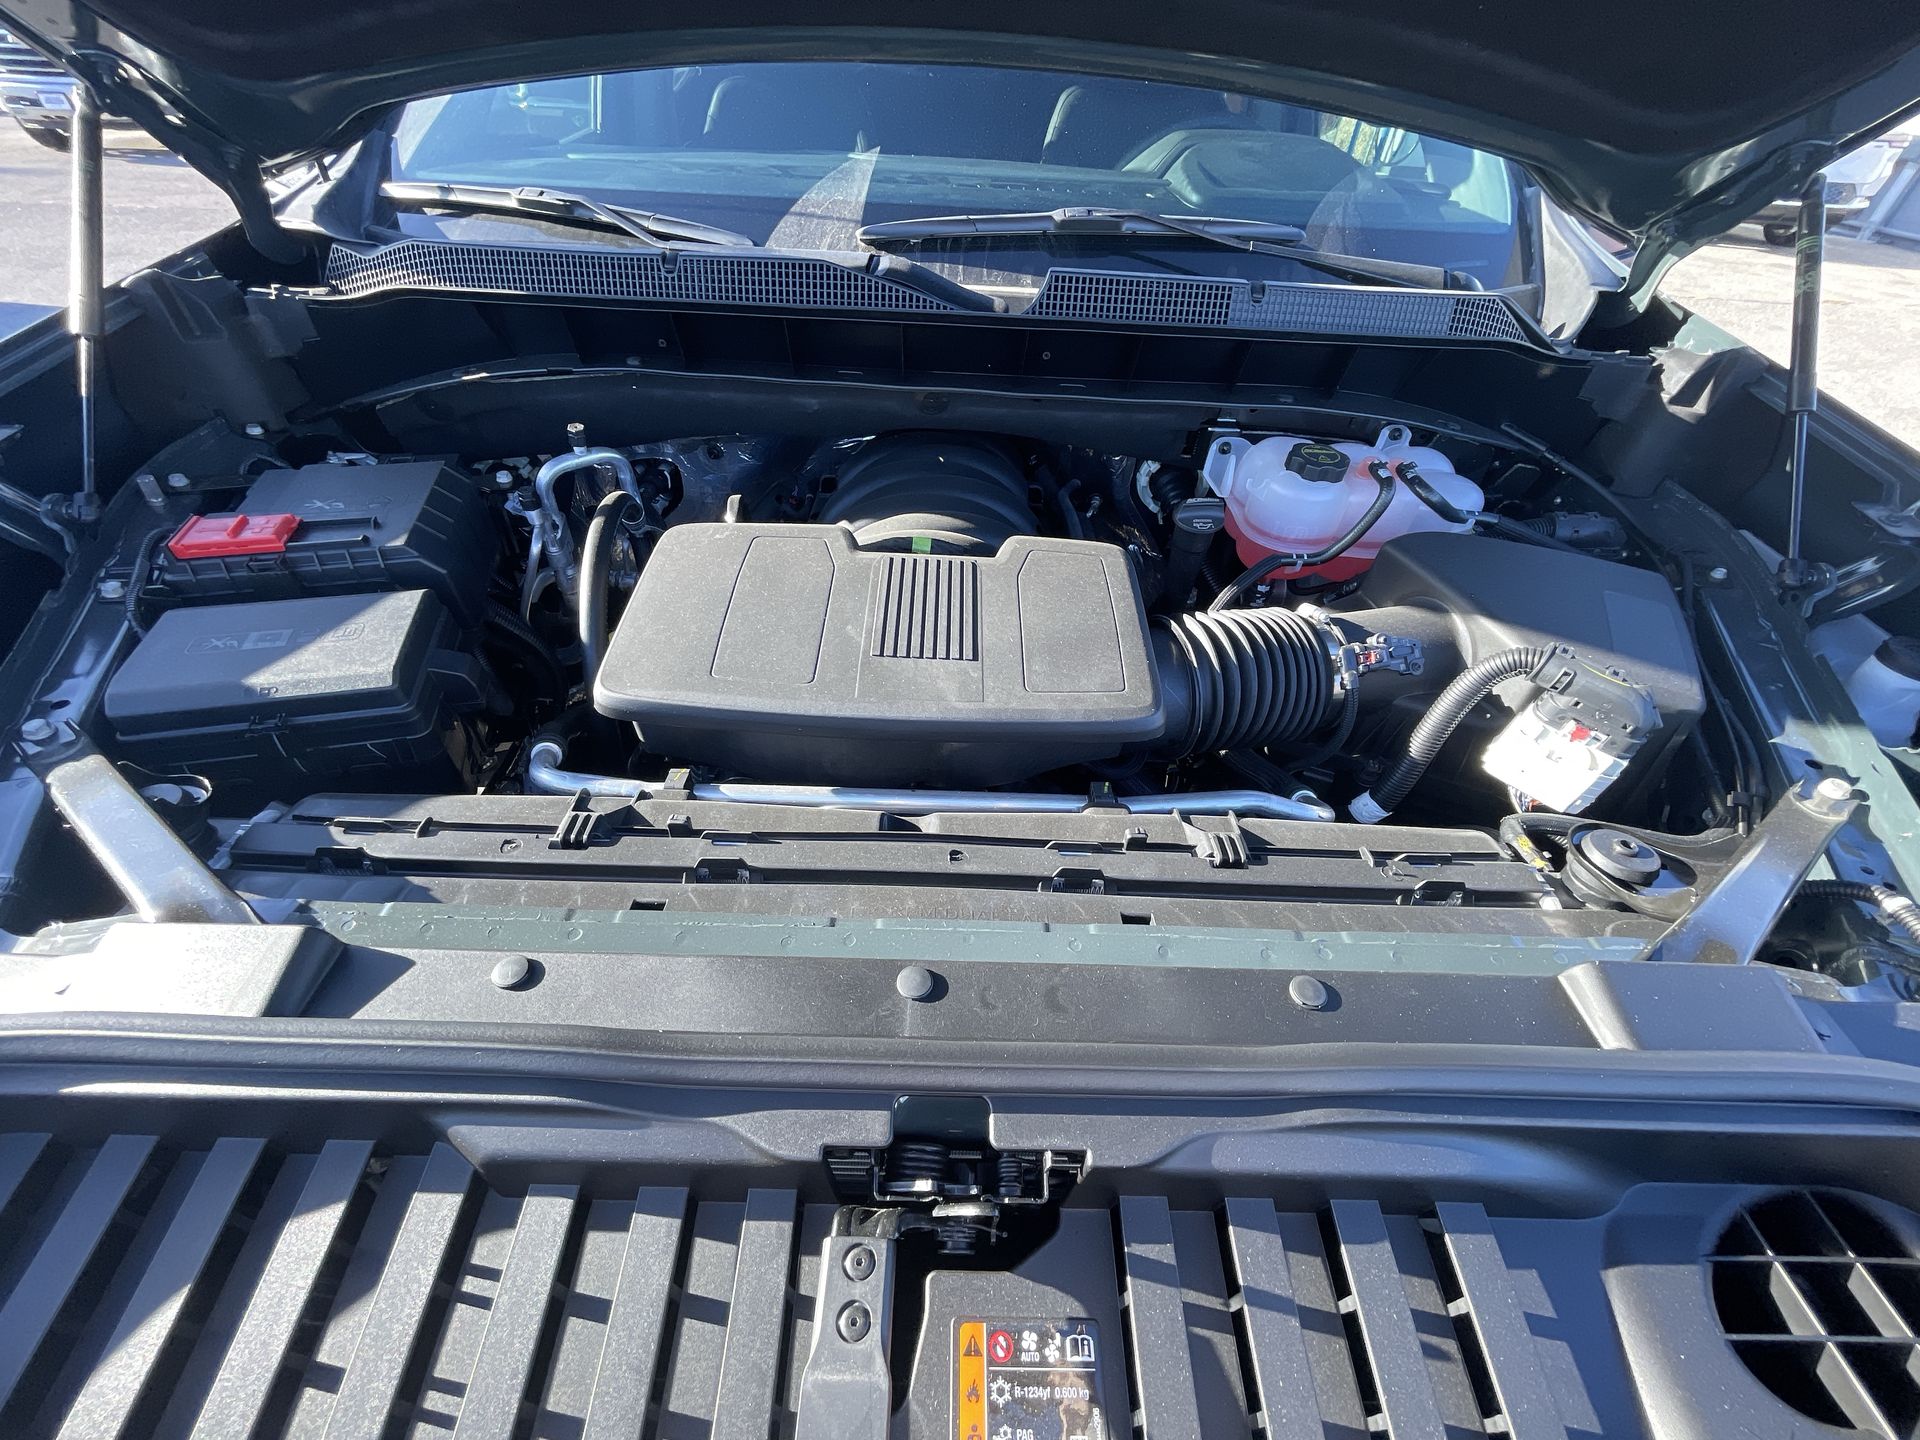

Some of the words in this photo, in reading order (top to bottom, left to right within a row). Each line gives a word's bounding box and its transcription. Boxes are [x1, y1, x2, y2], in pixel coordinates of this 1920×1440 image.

[1021, 1351, 1040, 1362] AUTO
[1014, 1386, 1051, 1400] R-1234yf
[1054, 1386, 1077, 1399] 0.600
[1079, 1387, 1090, 1401] kg
[1016, 1428, 1034, 1440] PAG
